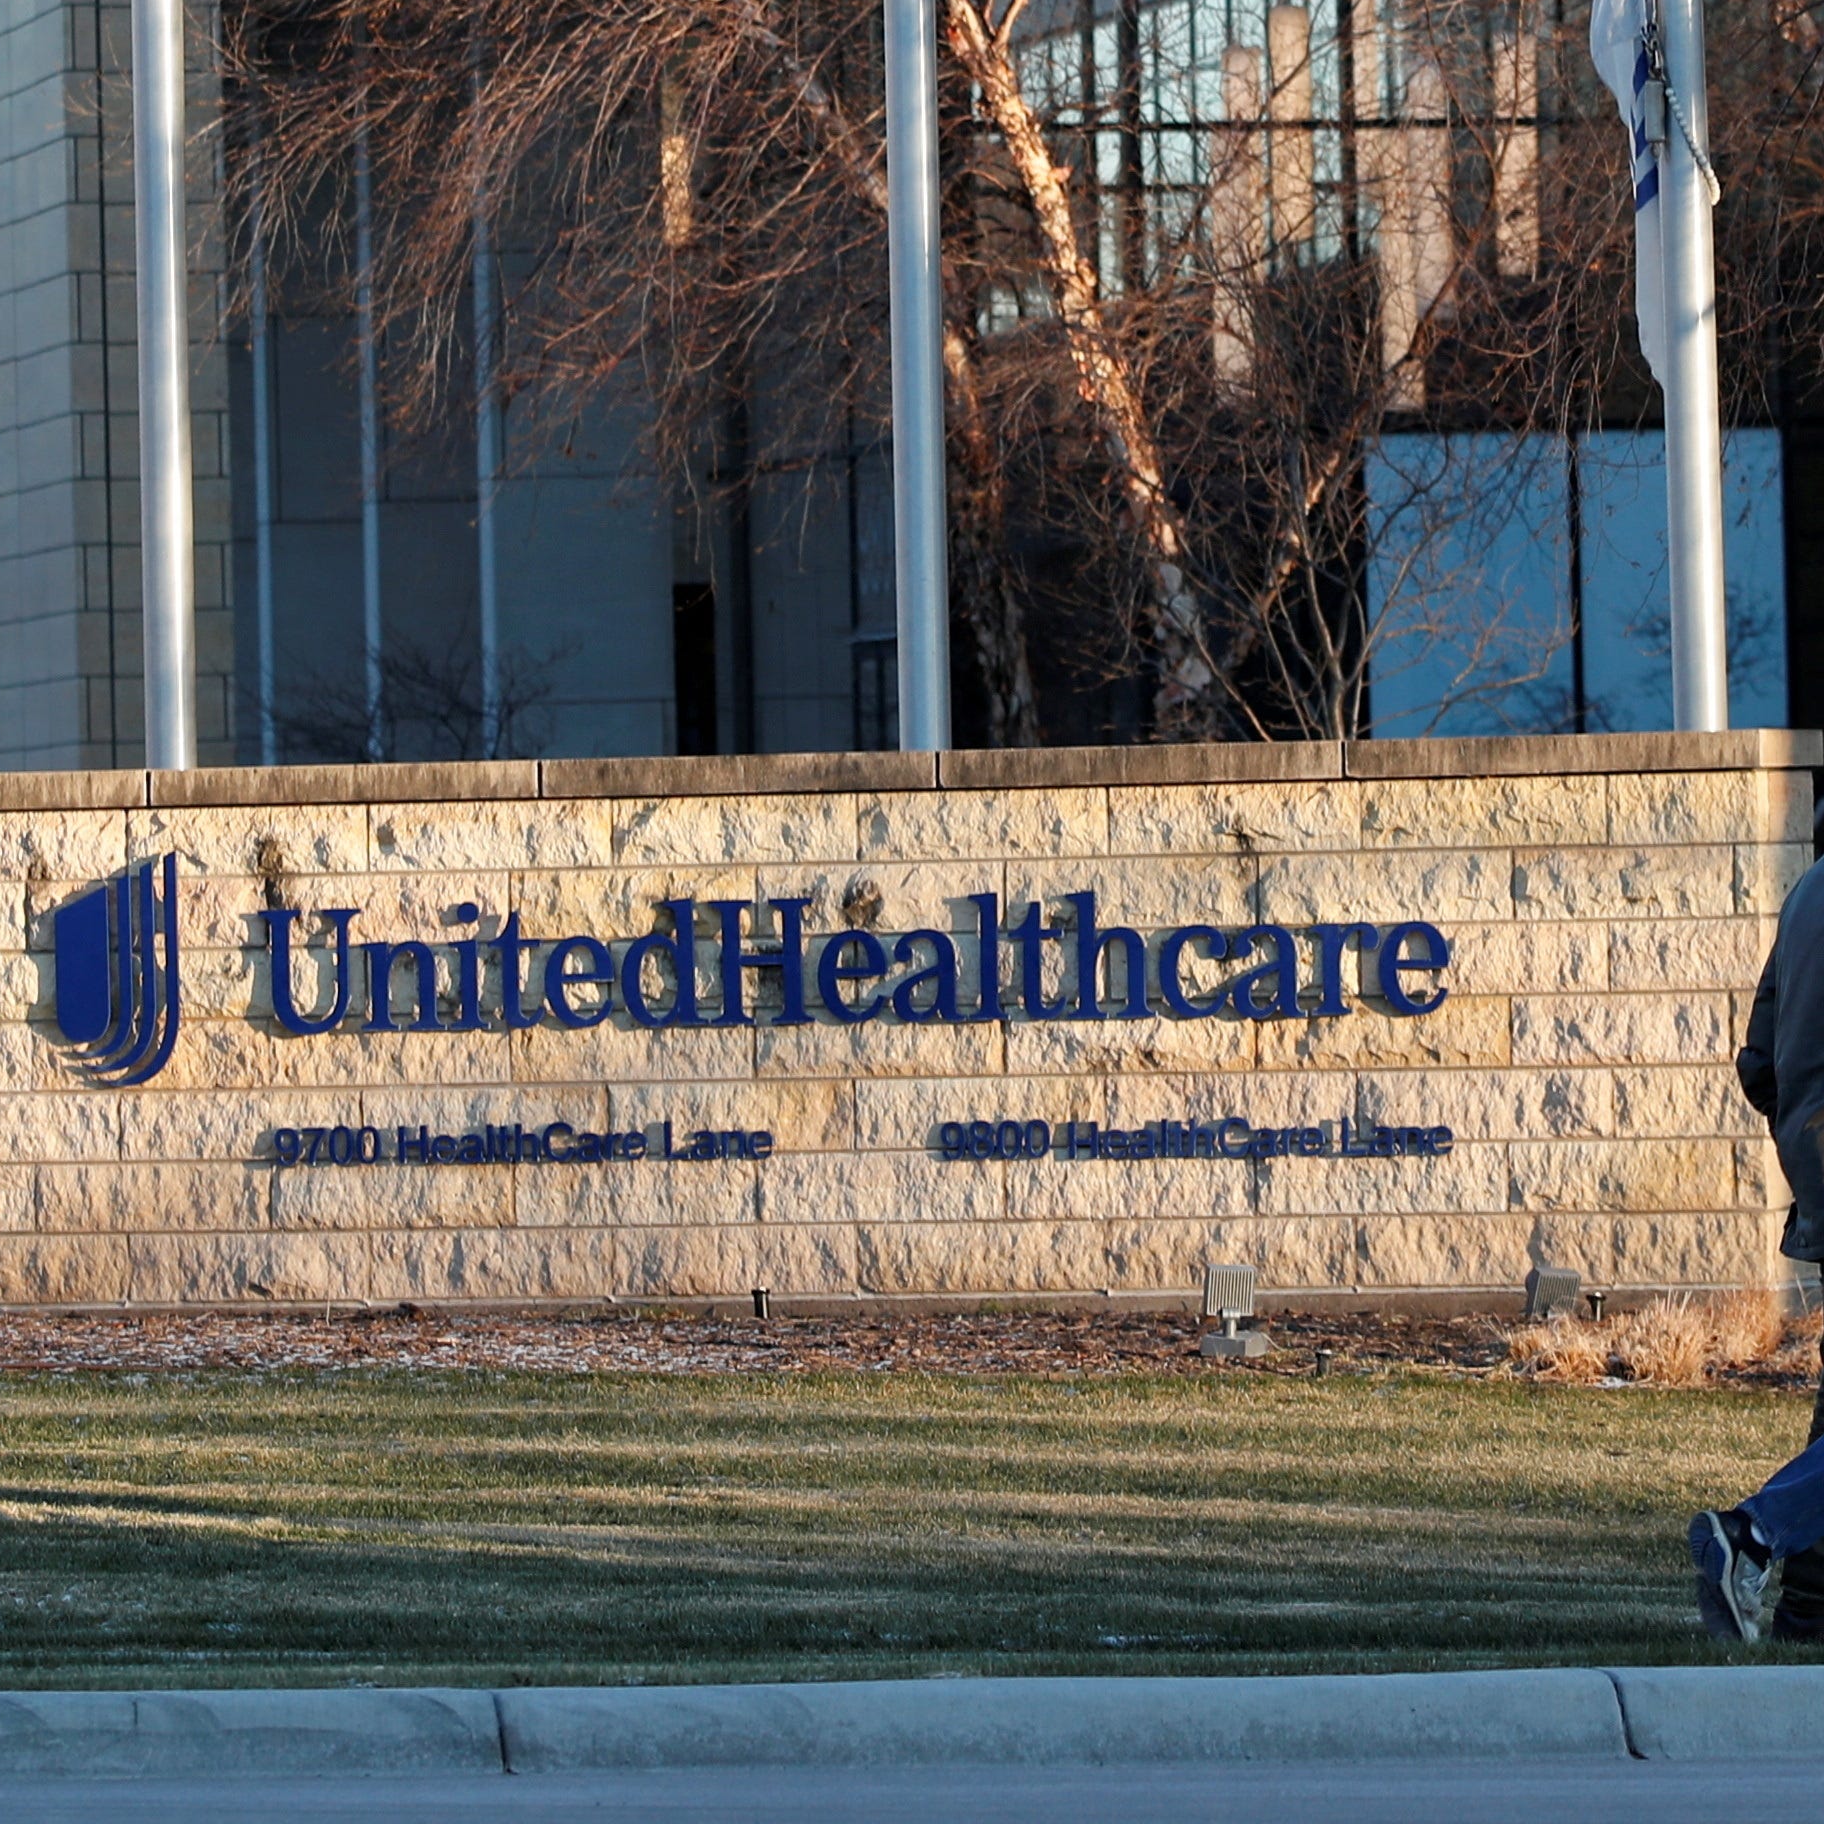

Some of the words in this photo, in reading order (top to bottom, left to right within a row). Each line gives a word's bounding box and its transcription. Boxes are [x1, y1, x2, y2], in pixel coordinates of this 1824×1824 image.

[258, 891, 1451, 1036] UnitedHealthcare
[273, 1125, 382, 1166] 9700
[397, 1122, 649, 1164] HealthCare
[663, 1121, 774, 1160] Lane
[940, 1119, 1051, 1160] 9800
[1067, 1117, 1327, 1159] HealthCare
[1341, 1116, 1453, 1156] Lane
